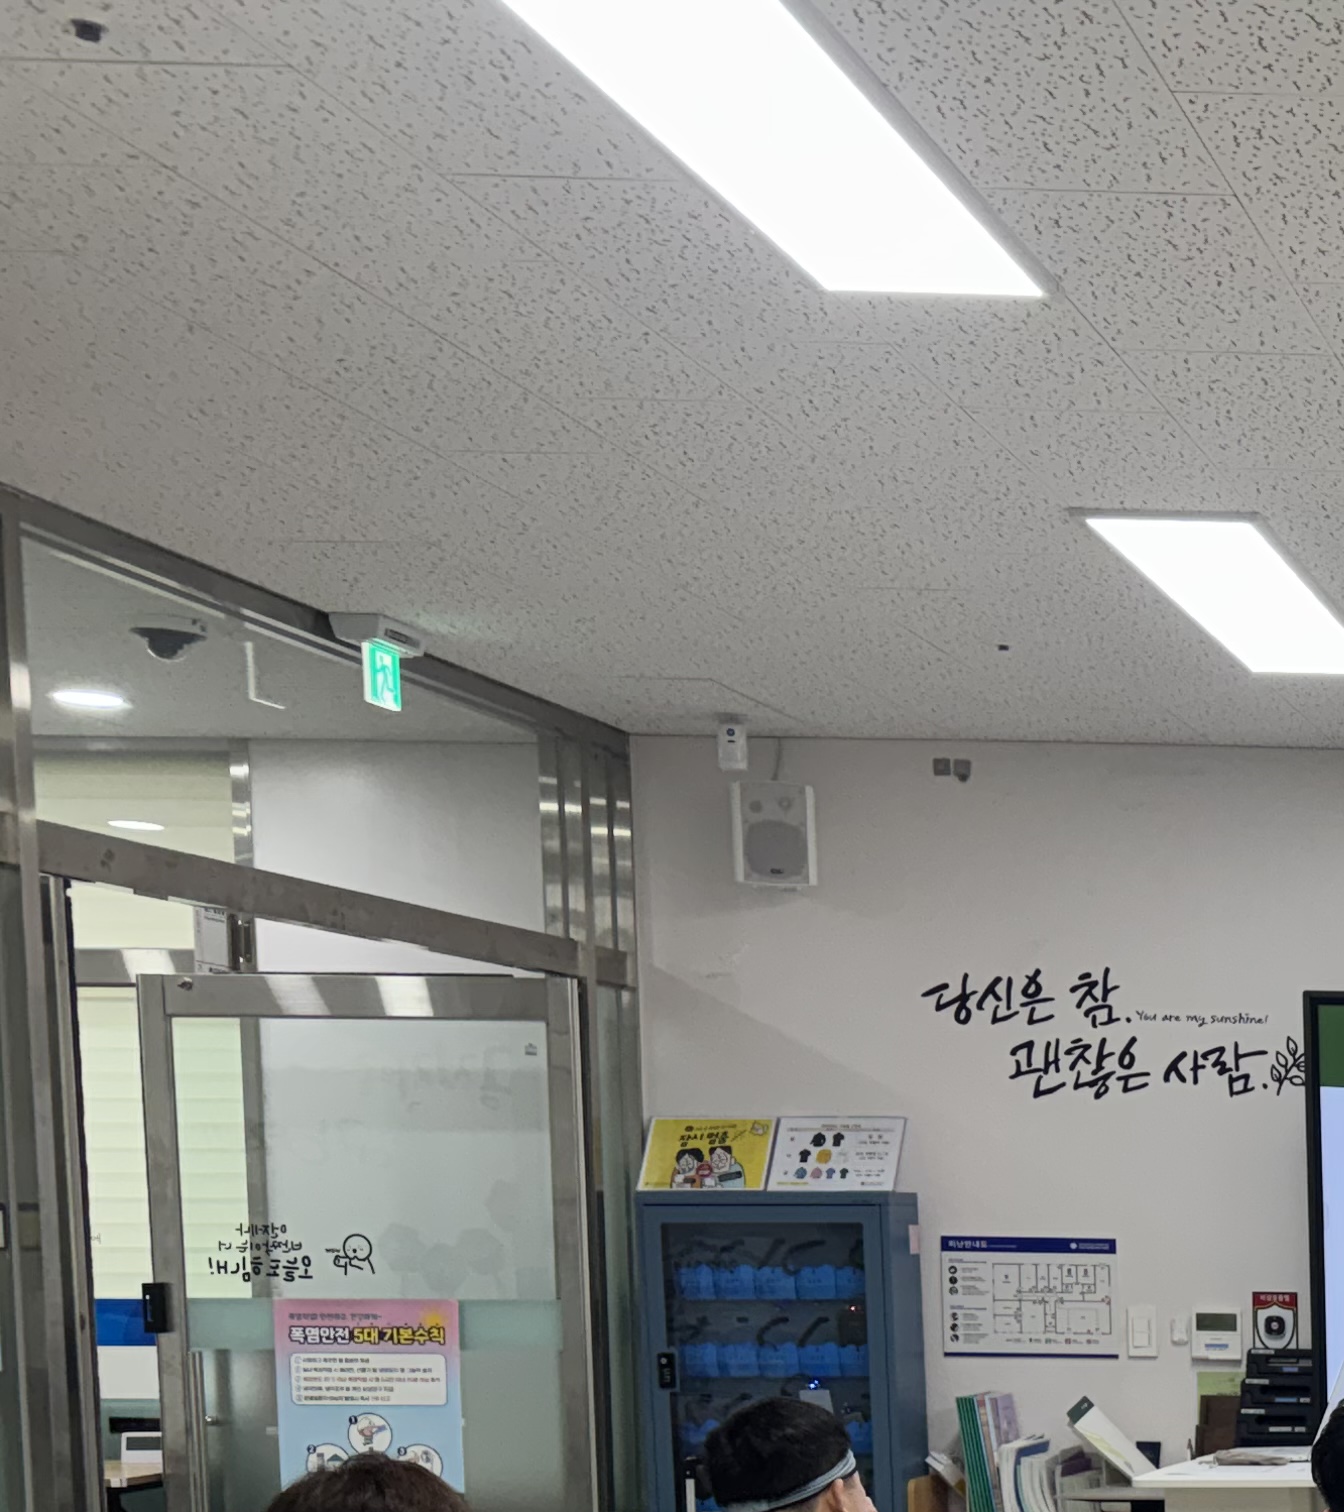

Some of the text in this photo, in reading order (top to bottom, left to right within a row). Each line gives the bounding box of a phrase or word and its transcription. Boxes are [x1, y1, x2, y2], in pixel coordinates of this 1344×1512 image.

[921, 966, 1132, 1028] 당신은 참.
[1136, 1010, 1269, 1028] You are my sunshine!
[1008, 1036, 1269, 1099] 괜찮은 사람.
[289, 1325, 446, 1346] 폭염안전 5대 기본수칙
